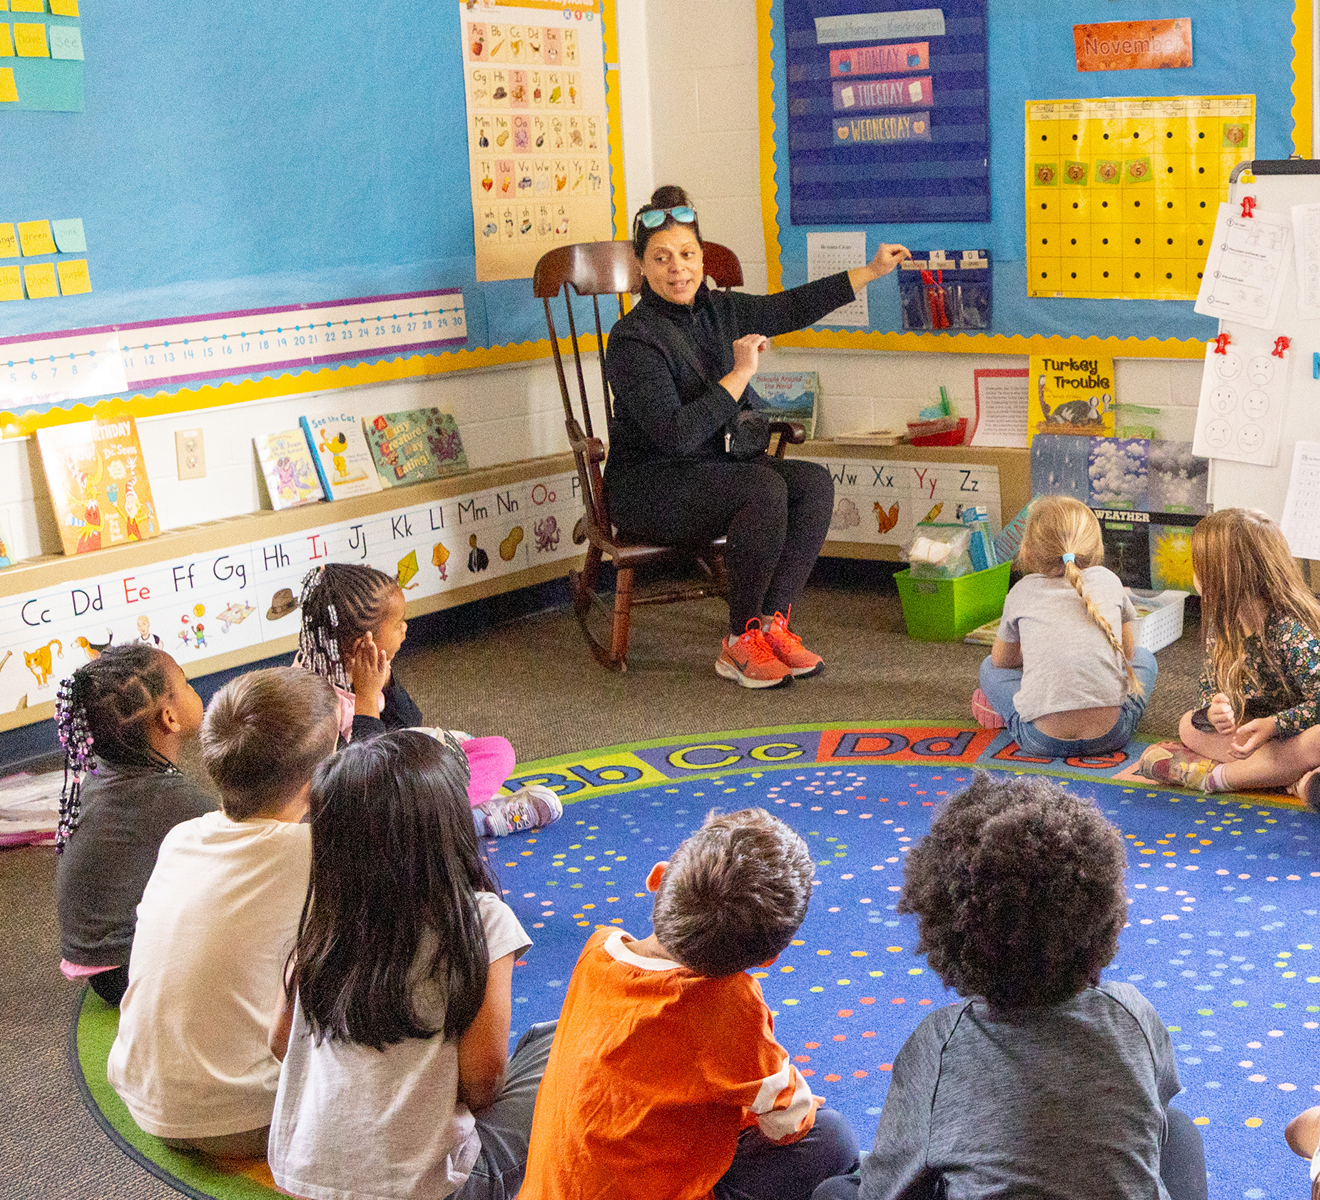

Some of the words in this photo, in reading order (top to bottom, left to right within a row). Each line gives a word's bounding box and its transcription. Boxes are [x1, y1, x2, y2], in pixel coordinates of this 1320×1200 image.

[472, 24, 483, 36] Aa
[491, 25, 501, 36] Bb
[510, 26, 520, 38] Cc
[528, 28, 538, 39] Dd
[546, 29, 556, 40] Ee
[564, 30, 573, 40] Ff
[1083, 34, 1183, 57] November
[857, 47, 900, 72] MONDAY
[473, 70, 486, 85] Gg
[493, 71, 504, 82] Hh
[549, 74, 558, 83] Kk
[858, 82, 903, 106] TUESDAY
[475, 116, 490, 127] Mm
[496, 117, 507, 127] Nn
[514, 116, 527, 127] Oo
[534, 117, 543, 131] Pp
[570, 118, 578, 127] Rr
[588, 118, 596, 128] Ss
[851, 116, 910, 141] WEDNESDAY
[481, 162, 490, 172] Tt
[499, 162, 510, 172] Uu
[518, 162, 529, 171] Vv
[535, 162, 549, 171] Ww
[555, 162, 565, 171] Xx
[573, 161, 582, 174] Yy
[591, 161, 599, 171] Zz
[485, 207, 495, 219] wh
[504, 207, 512, 218] ch
[523, 206, 530, 217] sh
[540, 206, 548, 216] th
[558, 206, 565, 215] ck
[24, 233, 48, 246] green
[31, 371, 38, 381] 6
[51, 367, 57, 377] 7
[72, 365, 78, 375] 8
[124, 357, 134, 368] 11
[144, 355, 155, 366] 12
[164, 352, 175, 362] 13
[183, 350, 195, 360] 14
[203, 347, 213, 357] 15
[222, 345, 232, 355] 16
[241, 343, 250, 353] 17
[259, 340, 269, 350] 18
[277, 337, 287, 347] 19
[294, 335, 305, 346] 20
[309, 334, 318, 344] 21
[325, 332, 336, 342] 22
[342, 330, 353, 340] 23
[359, 328, 369, 338] 24
[375, 326, 385, 336] 25
[391, 324, 402, 334] 26
[407, 322, 416, 332] 27
[423, 320, 432, 330] 28
[438, 318, 447, 328] 29
[453, 316, 462, 326] 30
[1042, 358, 1098, 375] Turkey
[1054, 374, 1110, 389] Trouble
[312, 418, 326, 428] See
[340, 413, 355, 423] Cat
[103, 447, 117, 459] Dr.
[115, 443, 137, 455] Seuss
[826, 464, 857, 485] Ww
[872, 466, 894, 487] Xx
[913, 468, 937, 499] Yy
[959, 470, 979, 492] Zz
[1094, 510, 1150, 523] WEATHER
[21, 599, 51, 626] Cc
[71, 585, 103, 616] Dd
[123, 577, 150, 603] Ee
[172, 563, 195, 592] Ff
[212, 555, 246, 589] Gg
[263, 544, 290, 570] Hh
[307, 534, 328, 560] Ii
[349, 524, 367, 559] Jj
[391, 514, 412, 540] Kk
[429, 507, 444, 530] Ll
[458, 499, 488, 524] Mm
[496, 491, 518, 515] Nn
[532, 484, 556, 505] Oo
[665, 743, 806, 770] Cc
[831, 731, 977, 757] Dd
